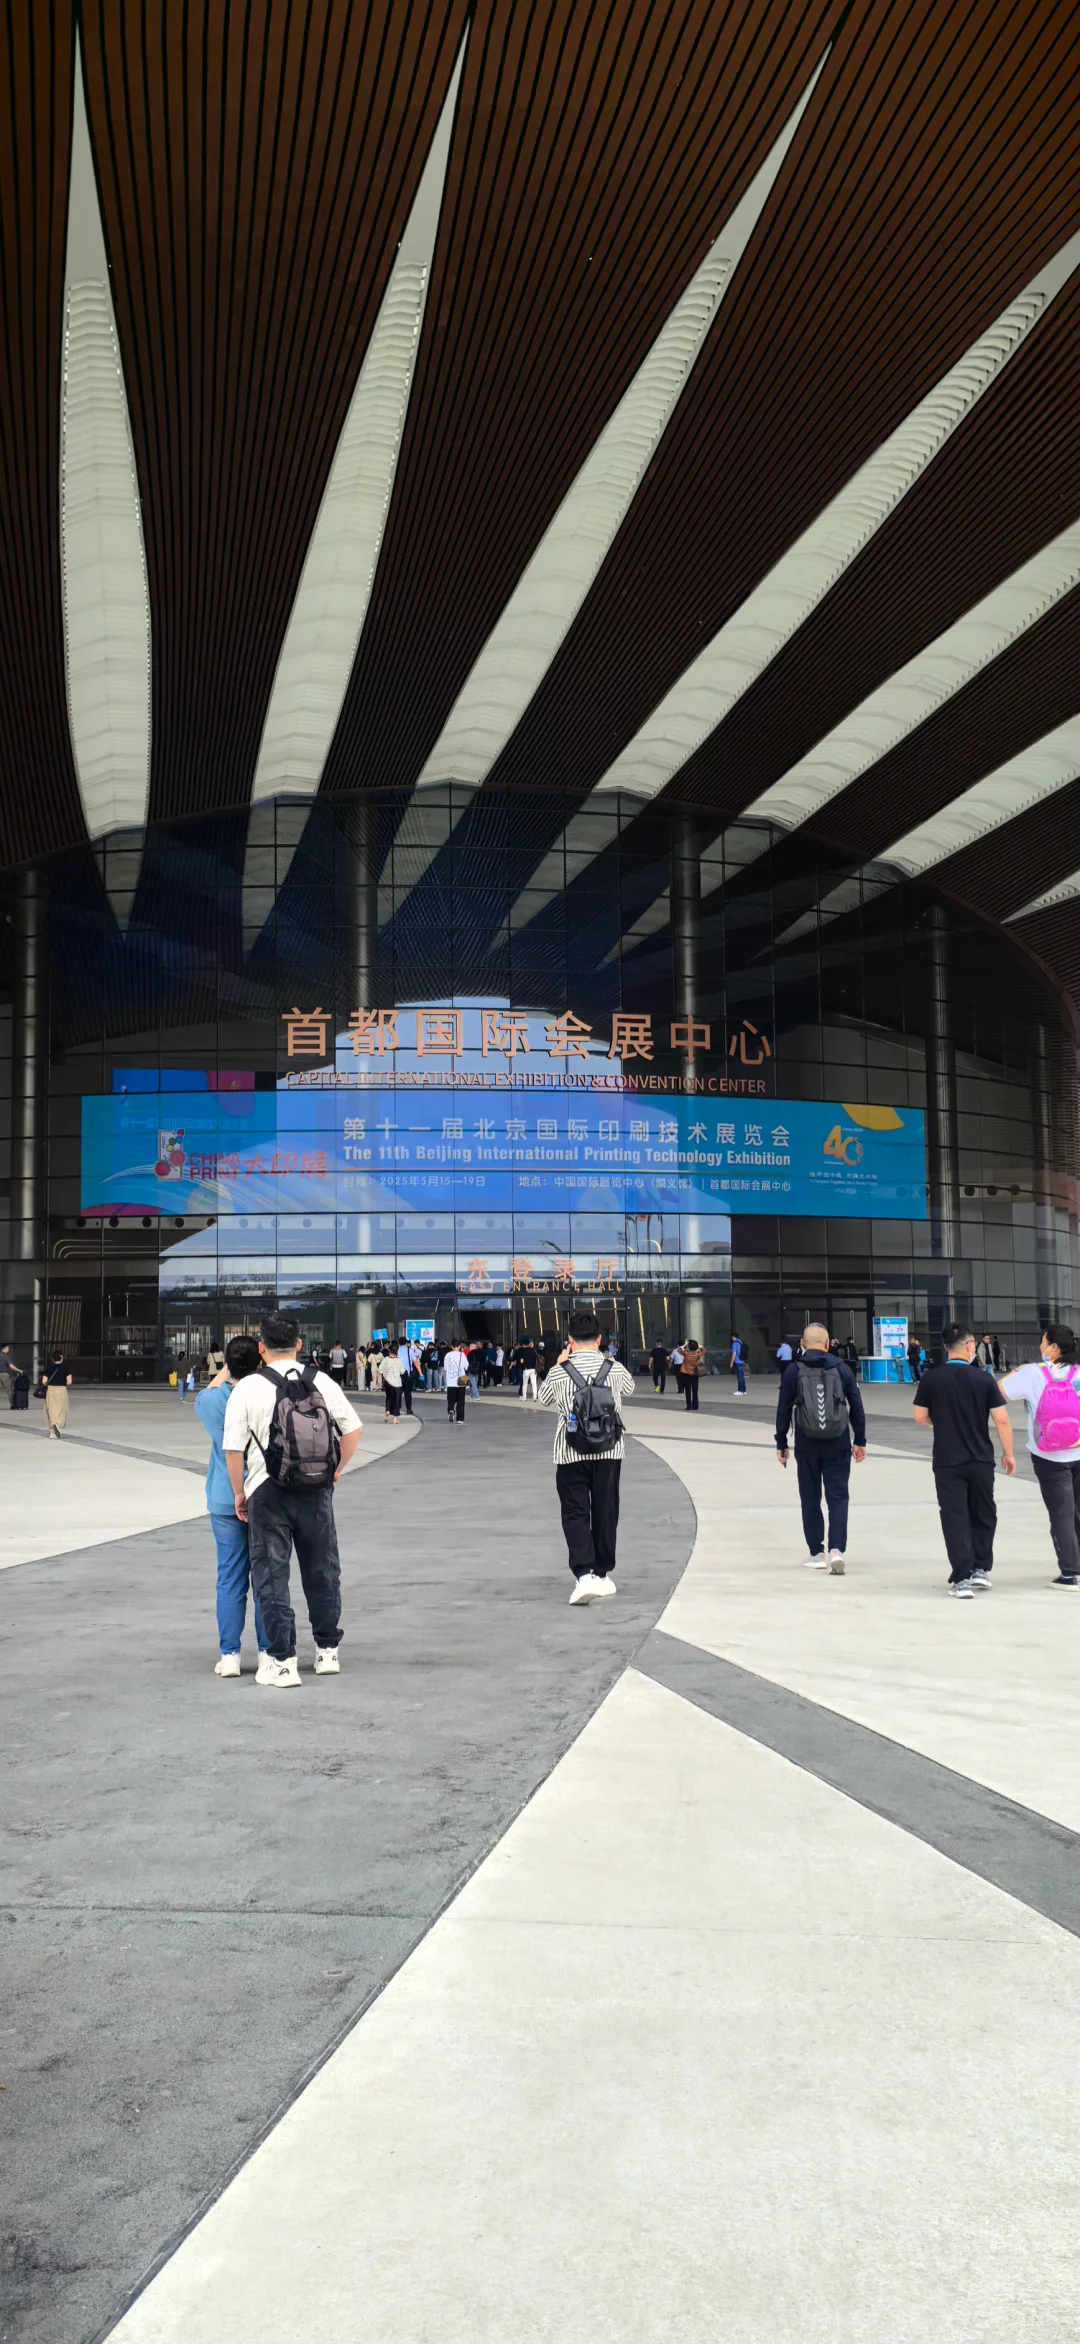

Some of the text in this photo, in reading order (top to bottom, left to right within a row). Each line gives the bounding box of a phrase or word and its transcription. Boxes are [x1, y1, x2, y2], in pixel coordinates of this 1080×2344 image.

[281, 1007, 772, 1066] 首都国际会展中心
[286, 1071, 355, 1086] CAPITAL
[358, 1071, 491, 1087] INTERNATIONAL
[495, 1072, 589, 1088] EXHIBITION
[604, 1074, 704, 1091] CONVENTION
[708, 1078, 766, 1093] CENTER
[342, 1117, 791, 1147] 第十一届北京国际印刷技术展览会
[189, 1152, 240, 1166] CHINA
[343, 1146, 791, 1166] The 11th Beijing International Printing Technology Exhibition
[189, 1166, 238, 1180] PRINT
[468, 1257, 618, 1281] 东登录厅
[460, 1281, 623, 1292] EAST ENTRANCE HALL
